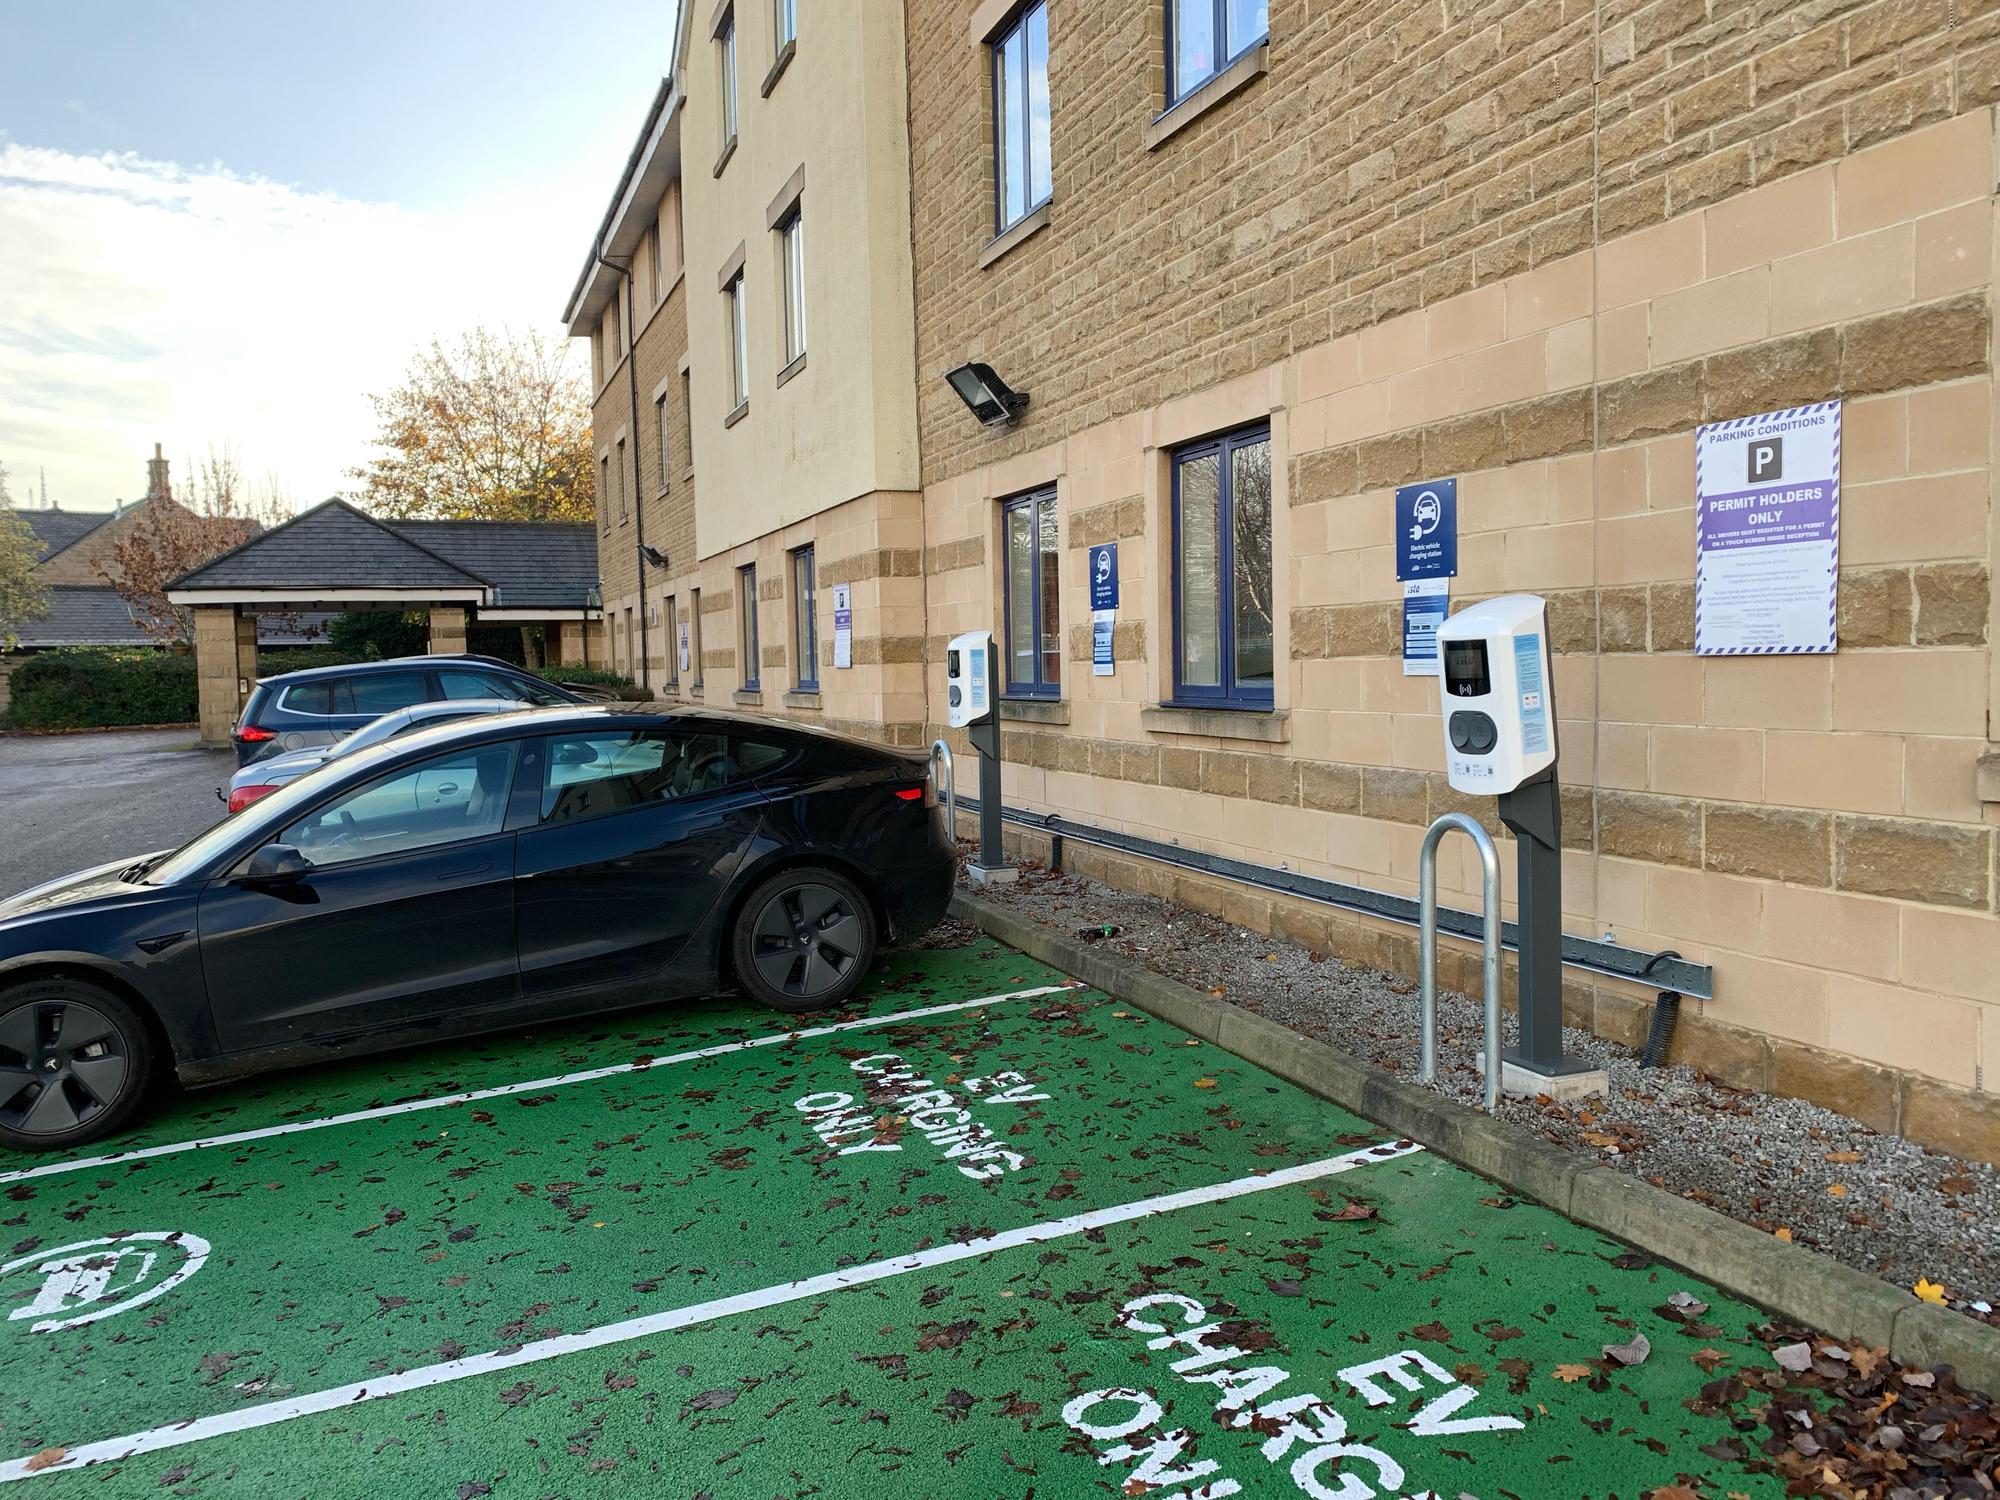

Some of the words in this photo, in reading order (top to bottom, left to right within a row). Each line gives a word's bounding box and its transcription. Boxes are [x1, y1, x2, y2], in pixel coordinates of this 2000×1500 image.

[1710, 428, 1754, 444] PARKING
[1757, 415, 1826, 436] CONDITIONS
[1755, 446, 1774, 475] P
[1709, 496, 1756, 513] PERMIT
[1760, 487, 1823, 509] HOLDERS
[1717, 530, 1740, 539] DRIVERS
[1741, 529, 1756, 537] MUST
[1757, 526, 1784, 536] REGISTER
[1803, 521, 1826, 530] PERMIT
[1748, 510, 1783, 525] ONLY
[1787, 531, 1820, 541] RECEPTION
[962, 1071, 1051, 1104] EV
[1337, 1349, 1526, 1436] EV
